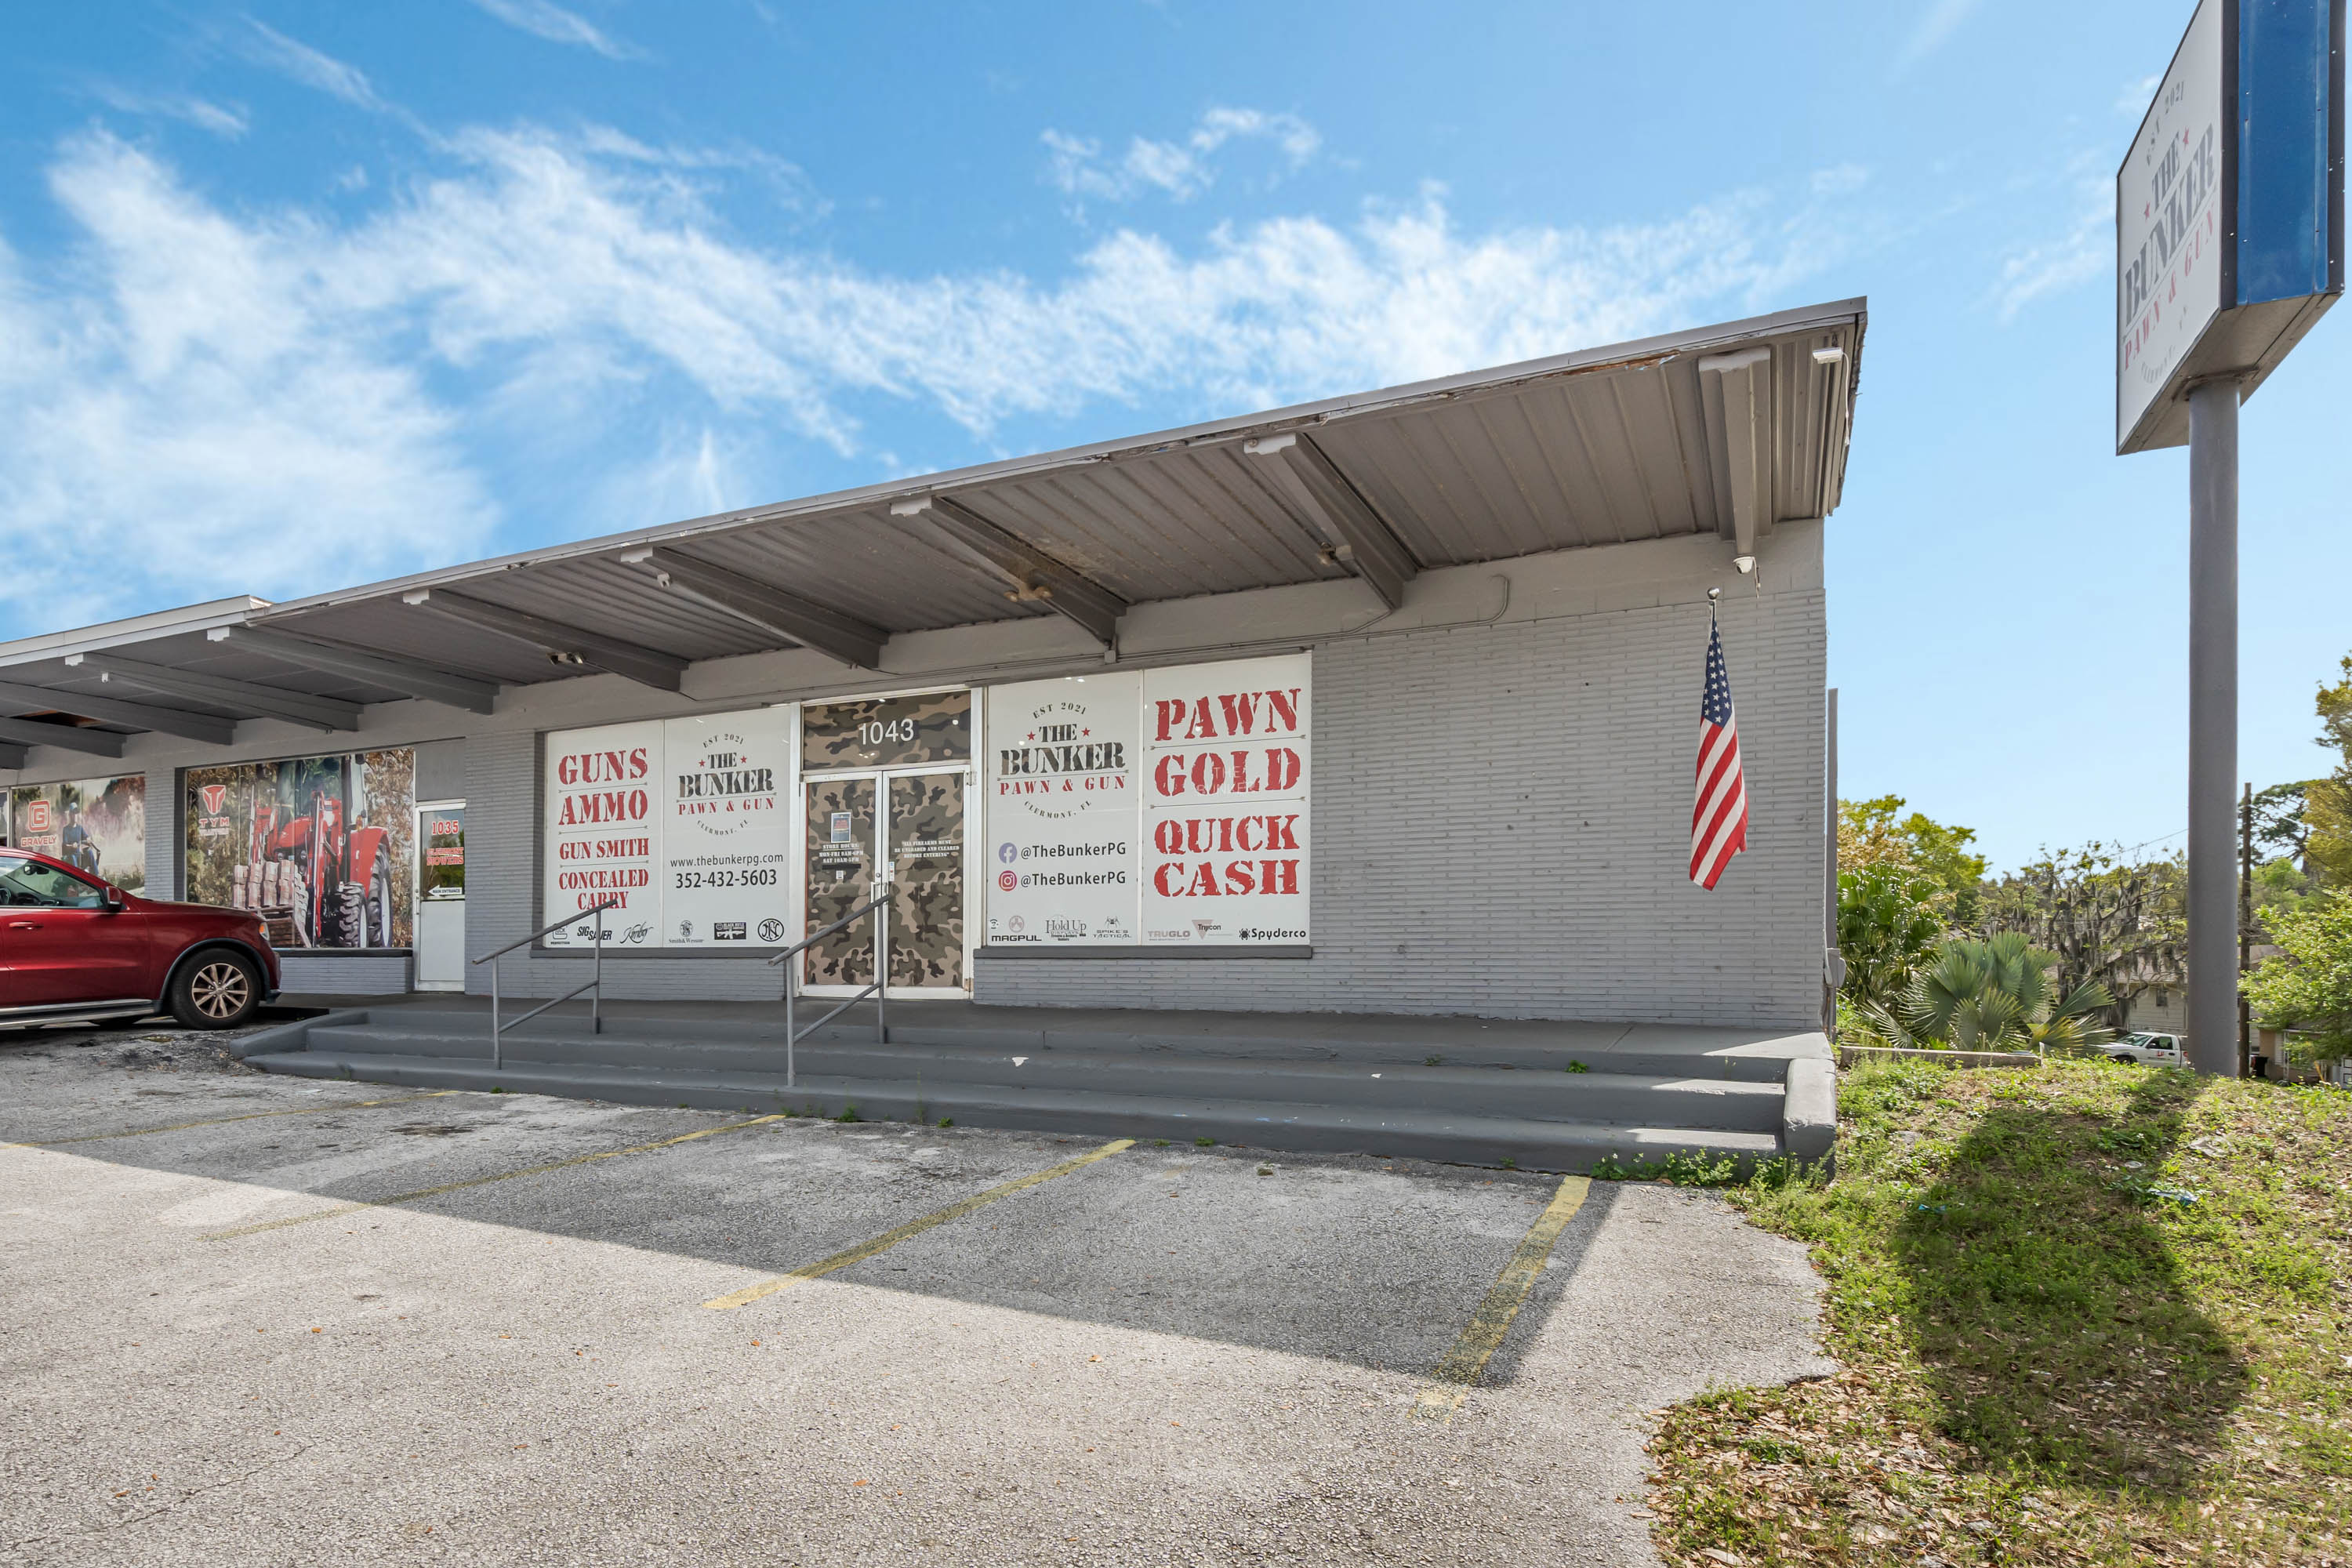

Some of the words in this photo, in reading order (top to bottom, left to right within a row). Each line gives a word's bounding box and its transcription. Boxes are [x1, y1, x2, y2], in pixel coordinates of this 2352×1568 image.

[2165, 82, 2183, 114] 2021
[2152, 132, 2180, 212] THE
[2125, 122, 2213, 327] BUNKER
[2125, 294, 2161, 371] PAWN
[2184, 201, 2214, 277] GUN
[1033, 703, 1053, 719] EST
[1061, 702, 1087, 715] 2021
[1155, 688, 1301, 741] PAWN
[702, 735, 719, 748] EST
[724, 733, 744, 745] 2021
[858, 718, 915, 745] 1043
[1039, 724, 1077, 742] THE
[558, 747, 648, 785] GUNS
[708, 753, 737, 769] THE
[1000, 742, 1126, 775] BUNKER
[1154, 747, 1301, 797] GOLD
[678, 768, 775, 798] BUNKER
[1000, 780, 1051, 795] PAWN
[1062, 779, 1073, 791] &
[1085, 775, 1126, 790] GUN
[557, 789, 648, 826] AMMO
[678, 801, 717, 815] PAWN
[726, 800, 735, 812] &
[743, 797, 774, 811] GUN
[1080, 800, 1092, 811] FL
[199, 817, 230, 828] TYM
[432, 821, 459, 835] 1035
[20, 834, 57, 848] GRAVELY
[1154, 814, 1300, 855] QUICK
[559, 841, 591, 860] GUN
[597, 838, 649, 858] SMITH
[1021, 842, 1126, 860] @TheBunkerPG
[426, 855, 464, 866] MOWERS
[670, 853, 784, 869] www.thebunkerpg.com
[558, 869, 649, 890] CONCEALED
[676, 869, 778, 888] 352-432-5603
[1021, 871, 1126, 887] @TheBunkerPG
[1154, 859, 1300, 897] CASH
[578, 891, 629, 910] CARRY
[577, 926, 590, 937] SIG
[1046, 920, 1069, 933] Hold
[1072, 920, 1087, 933] Up
[1251, 927, 1306, 940] Spyderco
